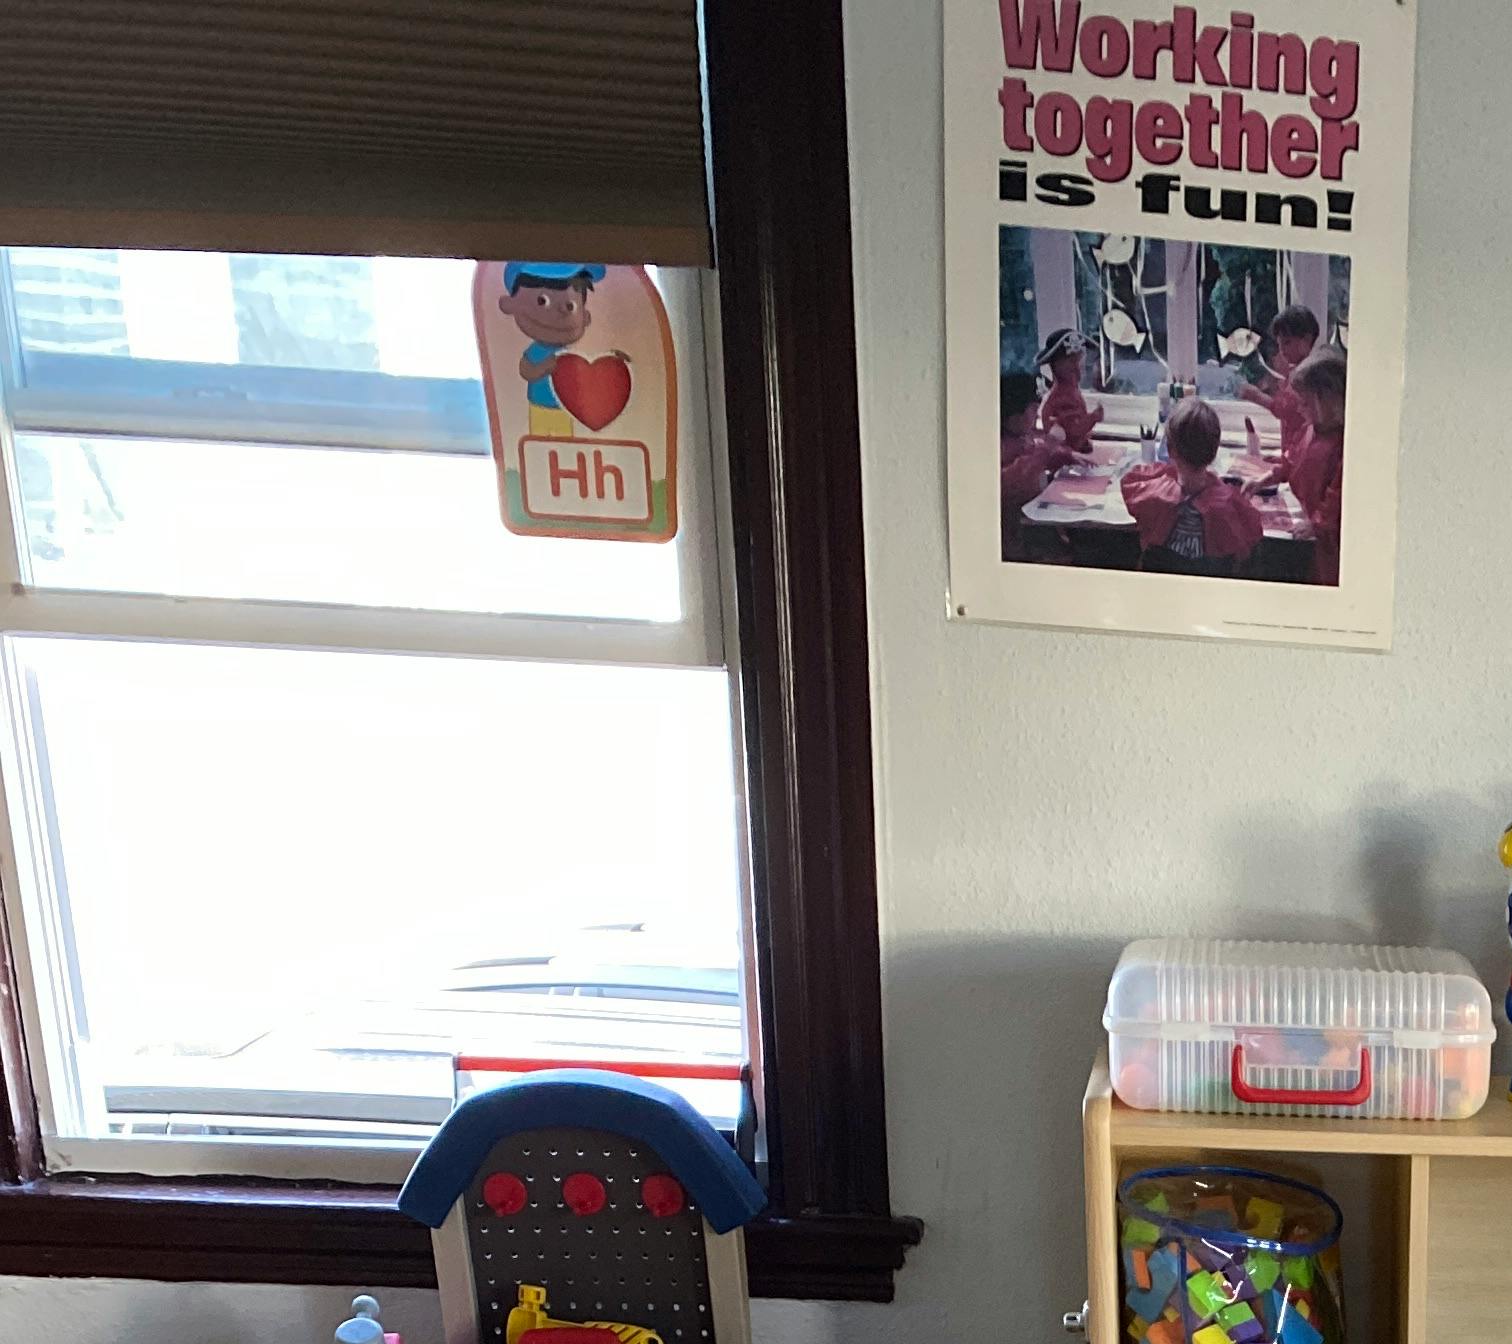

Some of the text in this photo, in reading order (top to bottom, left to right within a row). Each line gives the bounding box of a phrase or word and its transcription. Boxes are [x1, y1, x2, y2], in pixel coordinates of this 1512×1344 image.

[999, 0, 1360, 121] Working
[998, 76, 1360, 183] together
[999, 159, 1355, 232] is fun!
[548, 450, 625, 501] Hh
